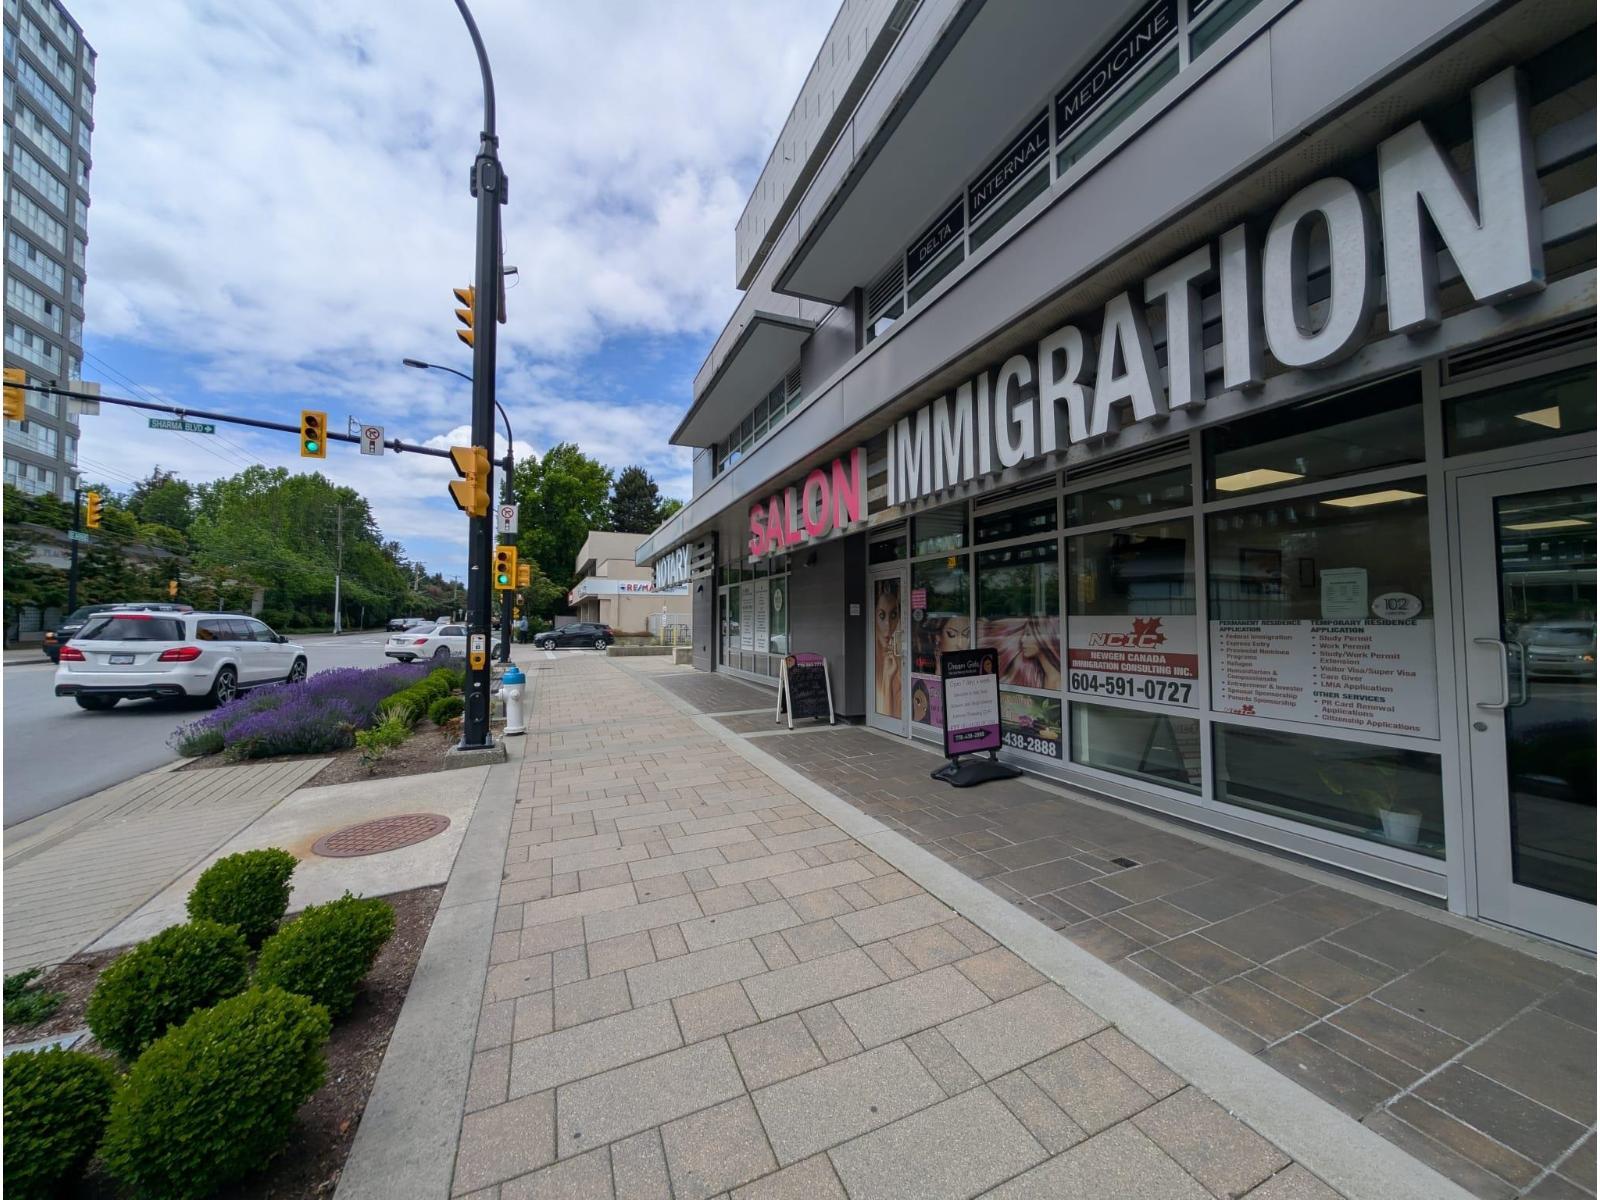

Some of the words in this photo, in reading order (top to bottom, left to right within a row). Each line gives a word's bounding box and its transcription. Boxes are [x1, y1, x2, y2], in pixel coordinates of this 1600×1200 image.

[918, 223, 951, 262] DELTA
[973, 134, 1047, 209] INTERNAL
[1063, 5, 1170, 121] MEDICINE
[886, 65, 1546, 508] IMMIGRATION
[151, 419, 183, 430] SHARMA
[184, 423, 204, 432] BLVD
[748, 447, 867, 558] SALON
[655, 544, 690, 589] NOTARY
[626, 583, 656, 592] RE/MA
[1383, 598, 1407, 611] 102
[1088, 632, 1158, 649] NCIC
[1090, 651, 1126, 660] NEWGEN
[1127, 652, 1167, 663] CANADA
[1370, 652, 1401, 660] Permit
[1072, 660, 1119, 671] IMMIGRATION
[1120, 662, 1172, 675] CONSULTING
[1173, 666, 1193, 676] INC.
[1347, 667, 1395, 677] Visa/Super
[1396, 669, 1417, 677] Visa
[1341, 674, 1363, 682] Giver
[1071, 672, 1193, 703] 604-591-0727
[1320, 681, 1342, 689] LMIA
[1343, 683, 1394, 693] Application
[1313, 691, 1340, 699] OTHER
[1342, 694, 1386, 703] SERVICES
[1321, 706, 1375, 718] Applications
[1356, 703, 1395, 713] Renewal
[1321, 714, 1365, 725] Citizenship
[1366, 720, 1421, 732] Applications
[1002, 731, 1057, 757] -438-2888
